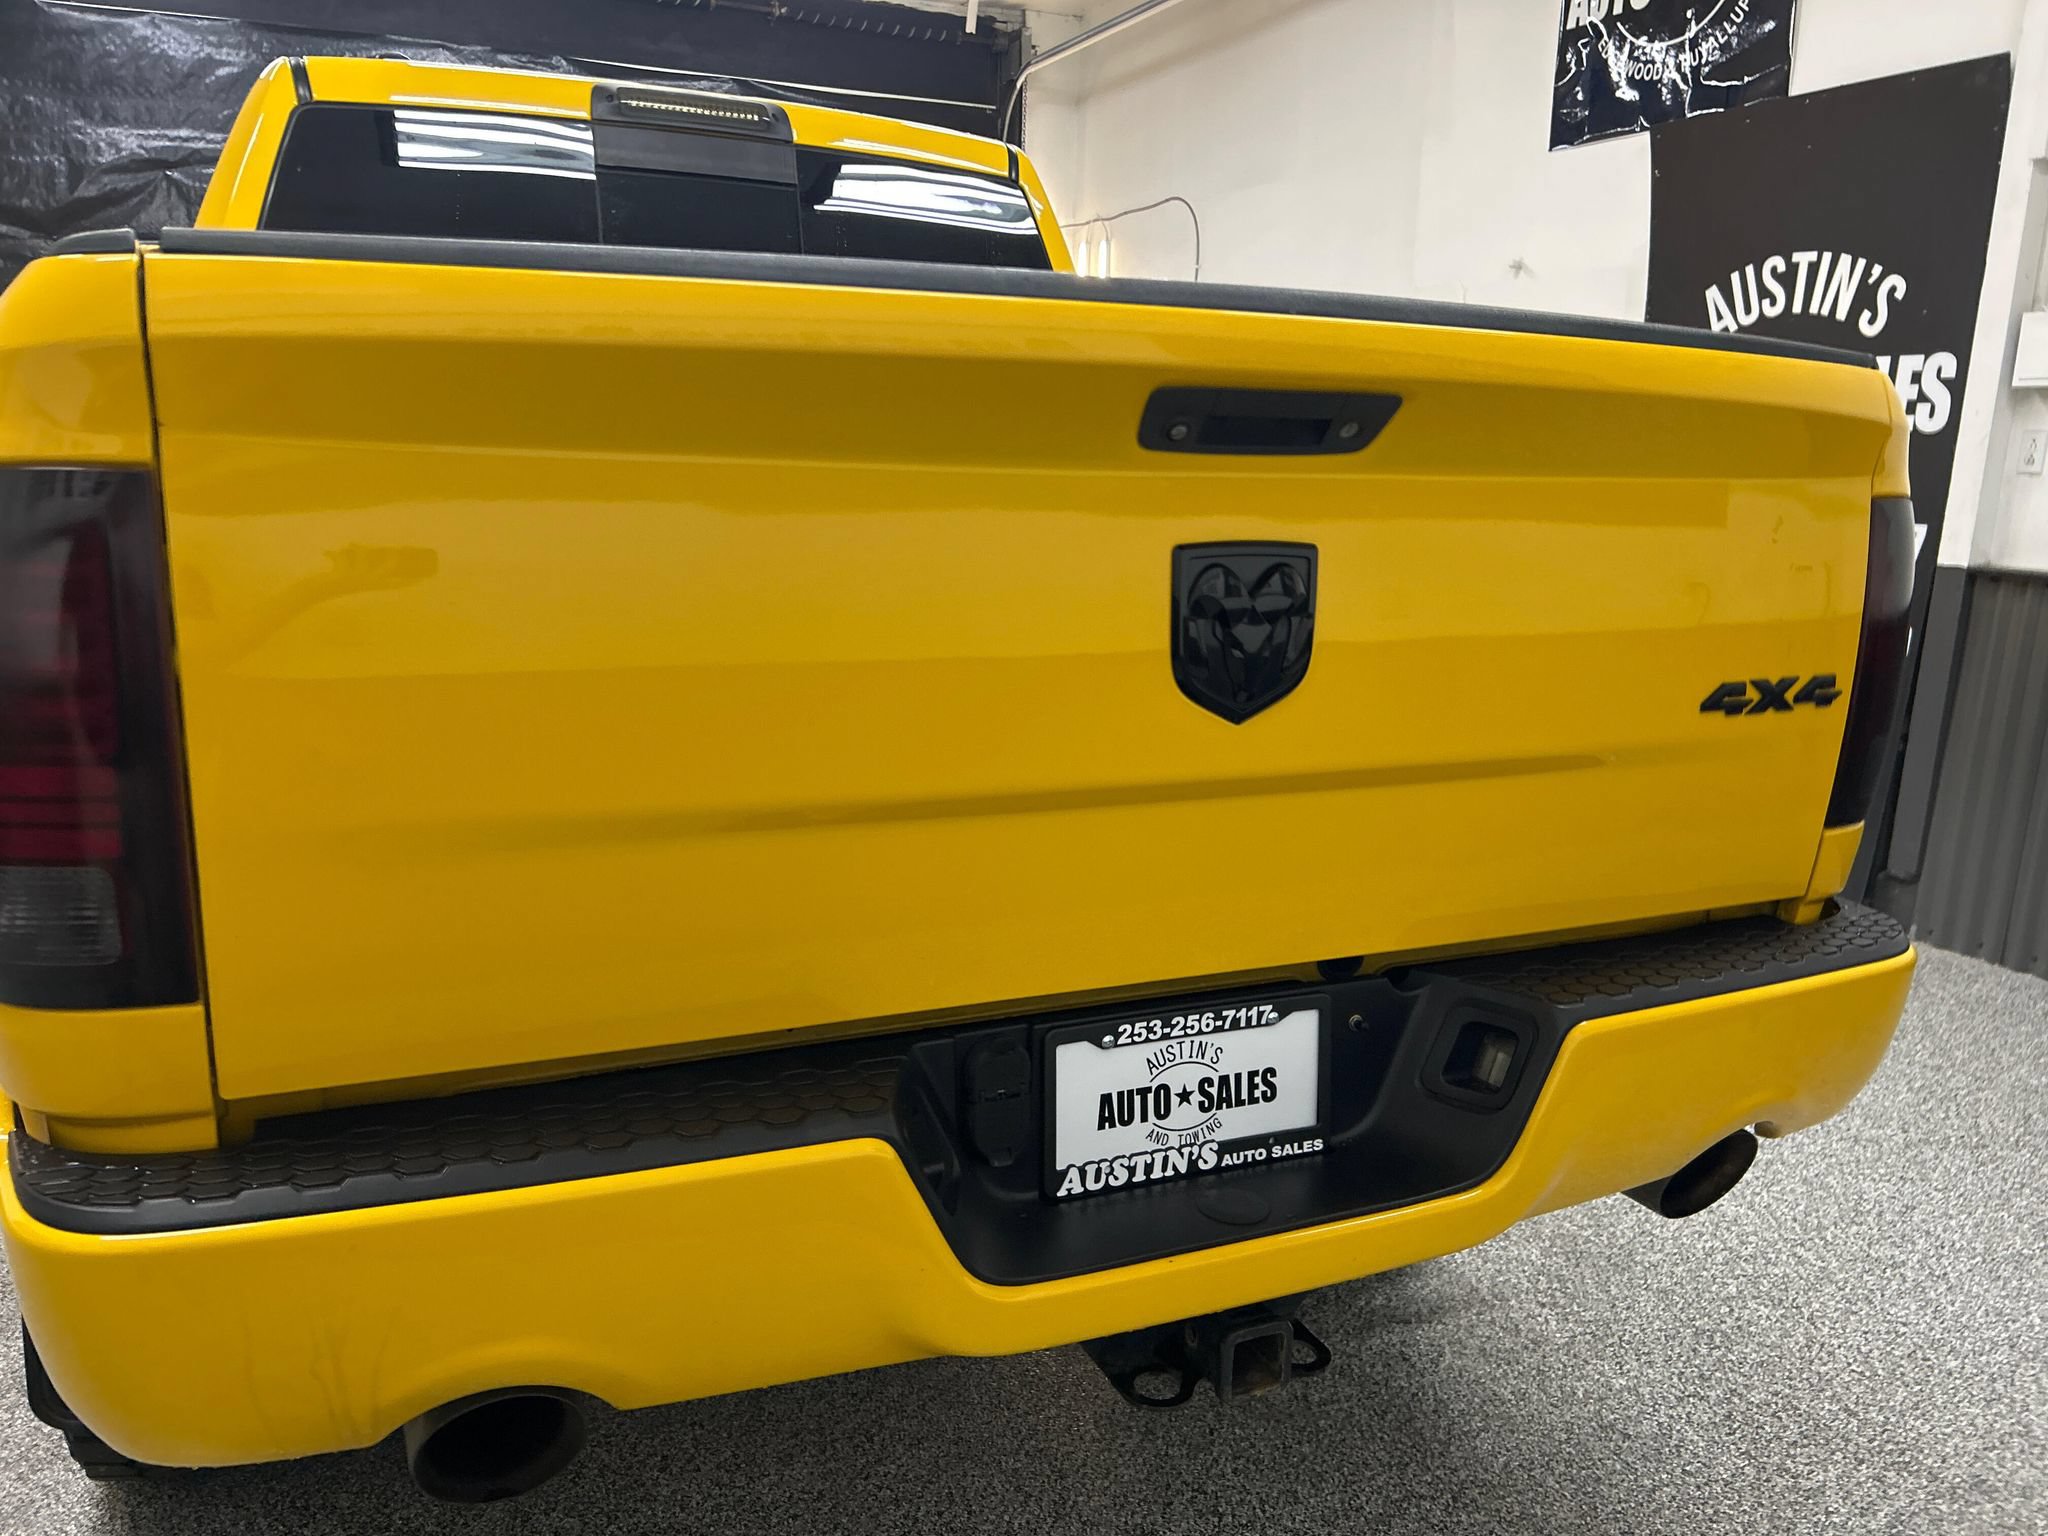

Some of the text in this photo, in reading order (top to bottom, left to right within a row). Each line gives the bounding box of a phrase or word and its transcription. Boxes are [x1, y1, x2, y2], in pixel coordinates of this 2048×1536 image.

[1704, 250, 1907, 338] AUSTIN'S
[1116, 1004, 1274, 1045] 253-256-7117
[1146, 1040, 1223, 1076] AUSTIN'S
[1097, 1066, 1278, 1131] AUTO SALES
[1145, 1117, 1223, 1146] AND TOWING
[1056, 1138, 1324, 1197] AUSTIN'S AUTO SALES
